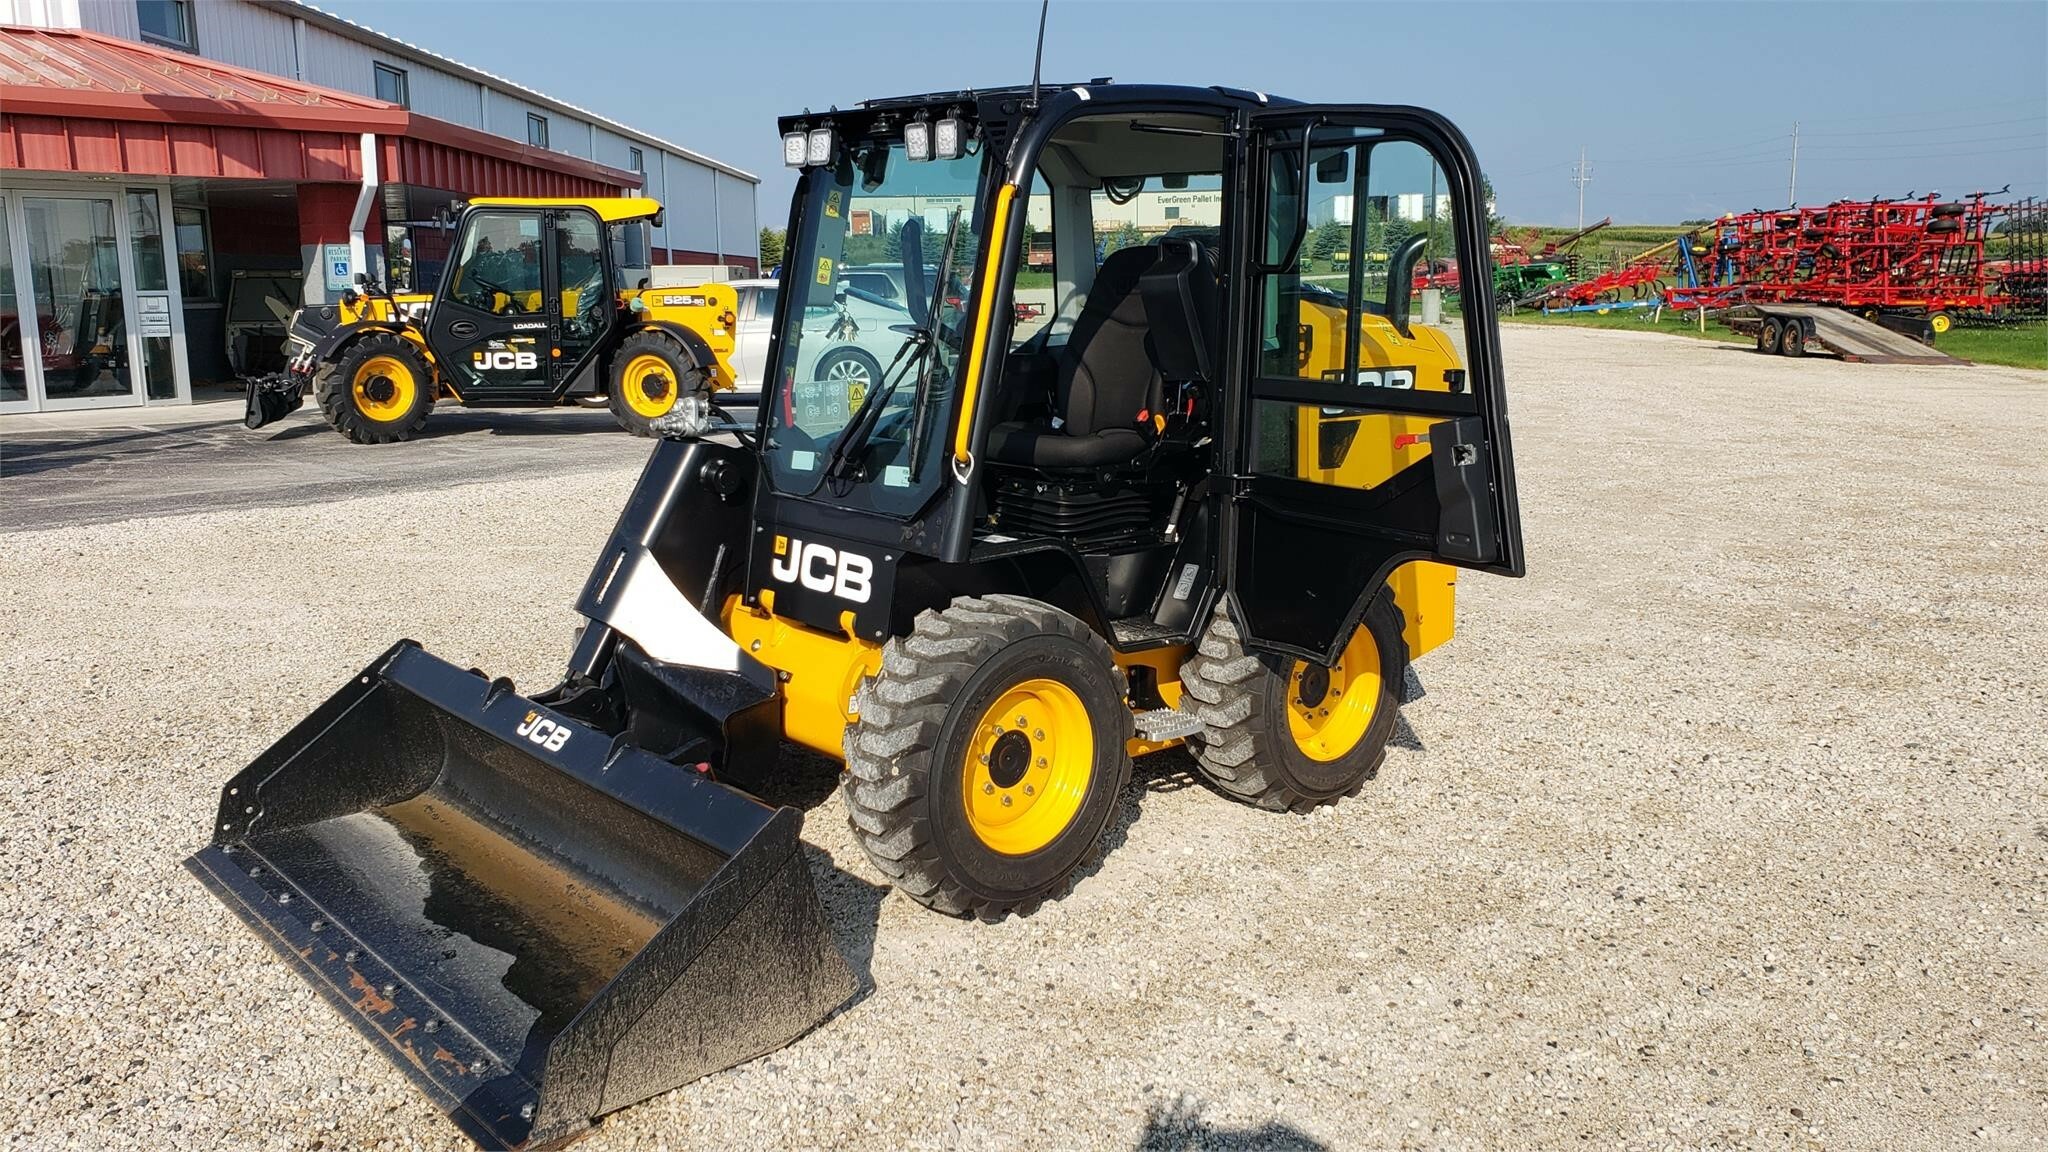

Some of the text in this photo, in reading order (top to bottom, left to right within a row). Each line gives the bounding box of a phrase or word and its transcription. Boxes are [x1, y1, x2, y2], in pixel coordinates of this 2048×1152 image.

[1158, 196, 1191, 204] EverGreen
[1193, 195, 1212, 203] Pallet
[513, 322, 548, 330] LOADALL
[473, 351, 538, 371] JCB
[771, 537, 874, 604] JCB
[516, 714, 573, 753] JCB
